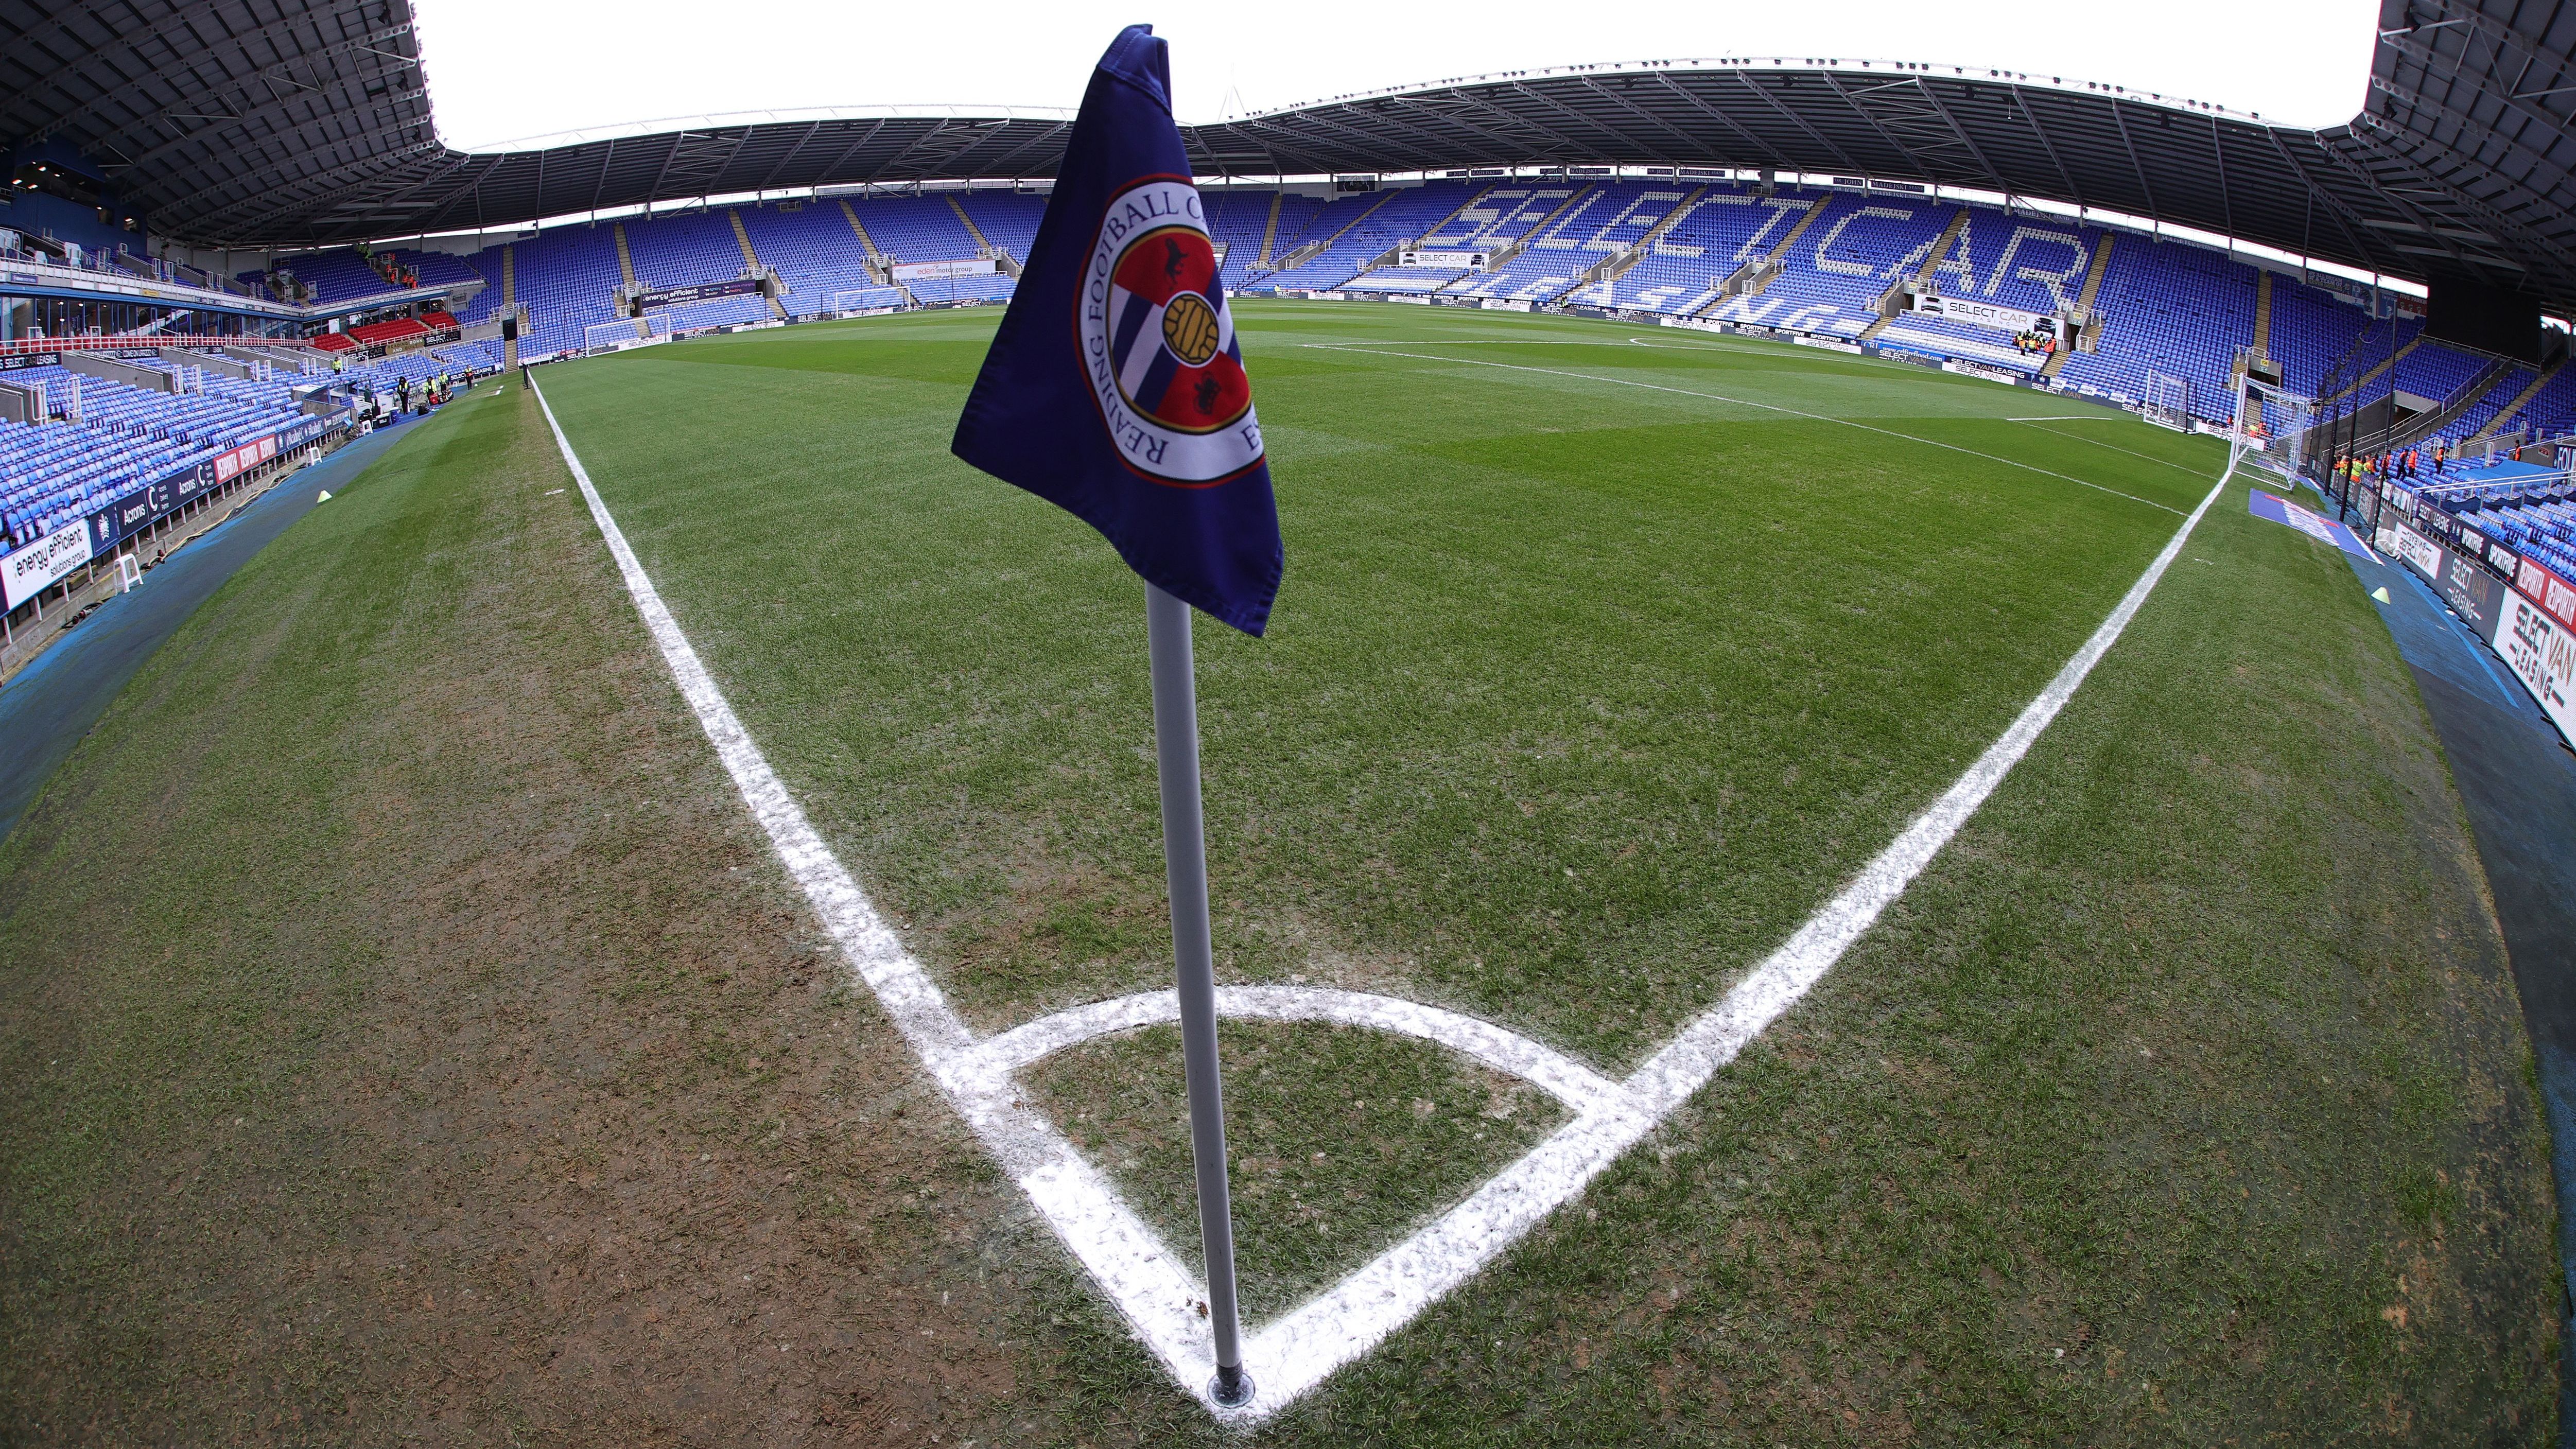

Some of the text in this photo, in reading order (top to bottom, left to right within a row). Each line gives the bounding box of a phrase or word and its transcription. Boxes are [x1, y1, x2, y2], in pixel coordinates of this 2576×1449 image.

[1872, 182, 1906, 190] MADEJSKI
[645, 288, 699, 302] energy efficient
[1950, 302, 2028, 324] SELECT CAR
[1966, 315, 2011, 326] LEASING
[1089, 191, 1179, 465] READING FOOTBALL
[1705, 319, 1734, 327] SPORTFIVE
[1739, 323, 1769, 332] SPORTFIVE
[426, 334, 446, 343] SELECT
[1735, 328, 1762, 336] SELECT
[1774, 328, 1805, 337] SPORTFIVE
[1810, 333, 1842, 342] SPORTFIVE
[5, 357, 25, 369] SELECT
[25, 356, 37, 366] CAR
[37, 354, 57, 365] LEASING
[348, 351, 369, 359] SELECT
[1879, 350, 1908, 360] SELECT
[1951, 358, 2025, 378] SELECT VAN LEASING
[1956, 365, 2001, 381] SELECT VAN
[2031, 382, 2062, 395] SELECT
[2063, 390, 2081, 399] VAN
[2207, 426, 2233, 438] SELEC
[179, 478, 196, 496] Acronis
[124, 502, 146, 526] Acronis
[2461, 527, 2484, 555] SPORTFIVE
[16, 525, 83, 577] energy efficient
[50, 549, 86, 577] solutions group
[2488, 544, 2518, 578] SPORTFIVE
[2450, 557, 2490, 606] SELECT VAN
[2451, 587, 2476, 619] LEASING
[2513, 603, 2576, 687] SELECT VAN
[2515, 643, 2554, 702] LEASING
